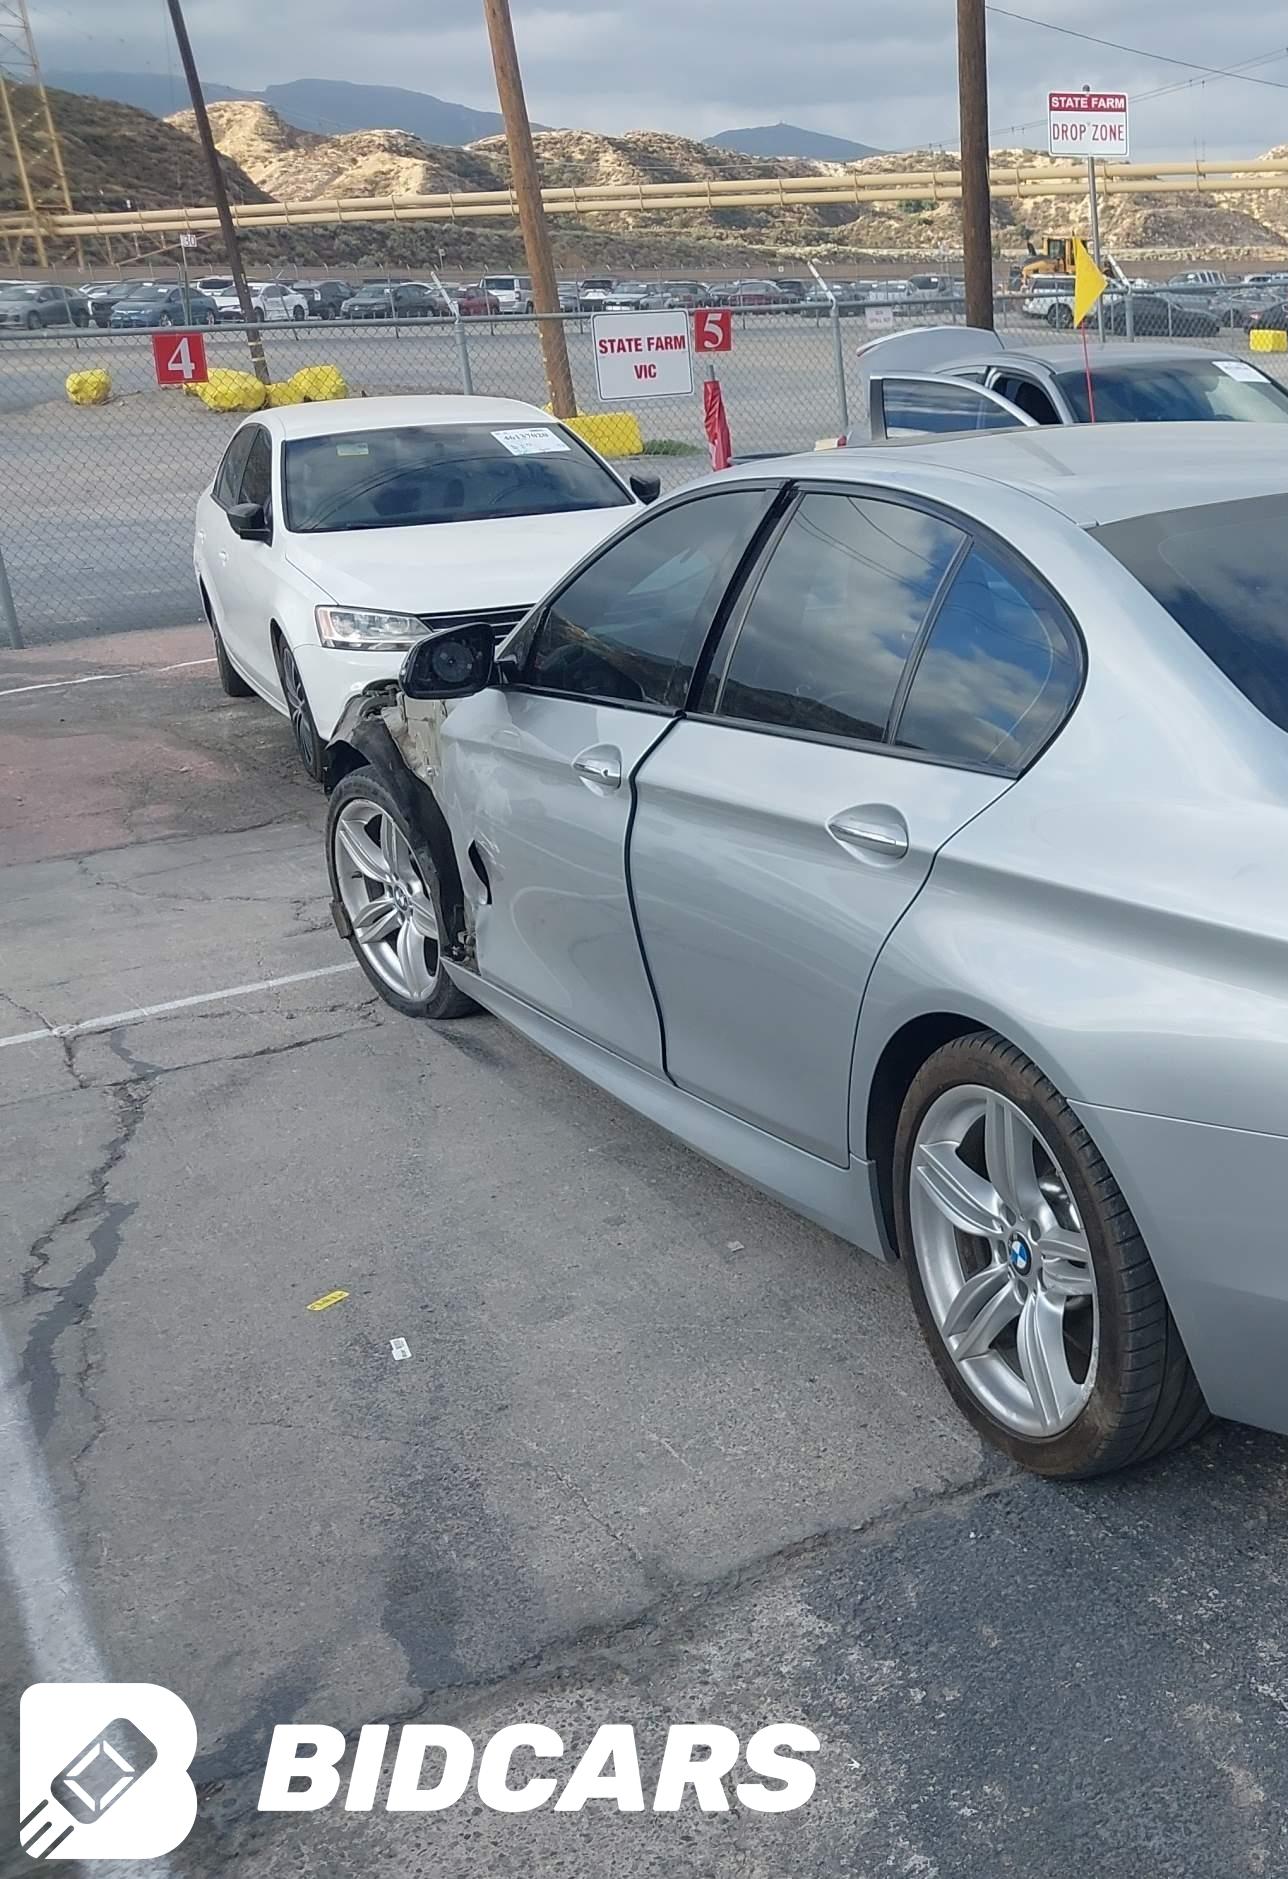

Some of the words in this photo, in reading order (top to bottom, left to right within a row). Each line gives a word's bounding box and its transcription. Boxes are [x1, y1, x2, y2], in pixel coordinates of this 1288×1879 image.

[1051, 96, 1088, 109] STATE
[1091, 97, 1125, 109] FARM
[1052, 123, 1087, 141] DROP
[1092, 124, 1125, 142] ZONE
[703, 312, 724, 349] 5
[598, 337, 643, 355] STATE
[647, 334, 686, 352] FARM
[167, 336, 196, 379] 4
[633, 363, 658, 380] VIC
